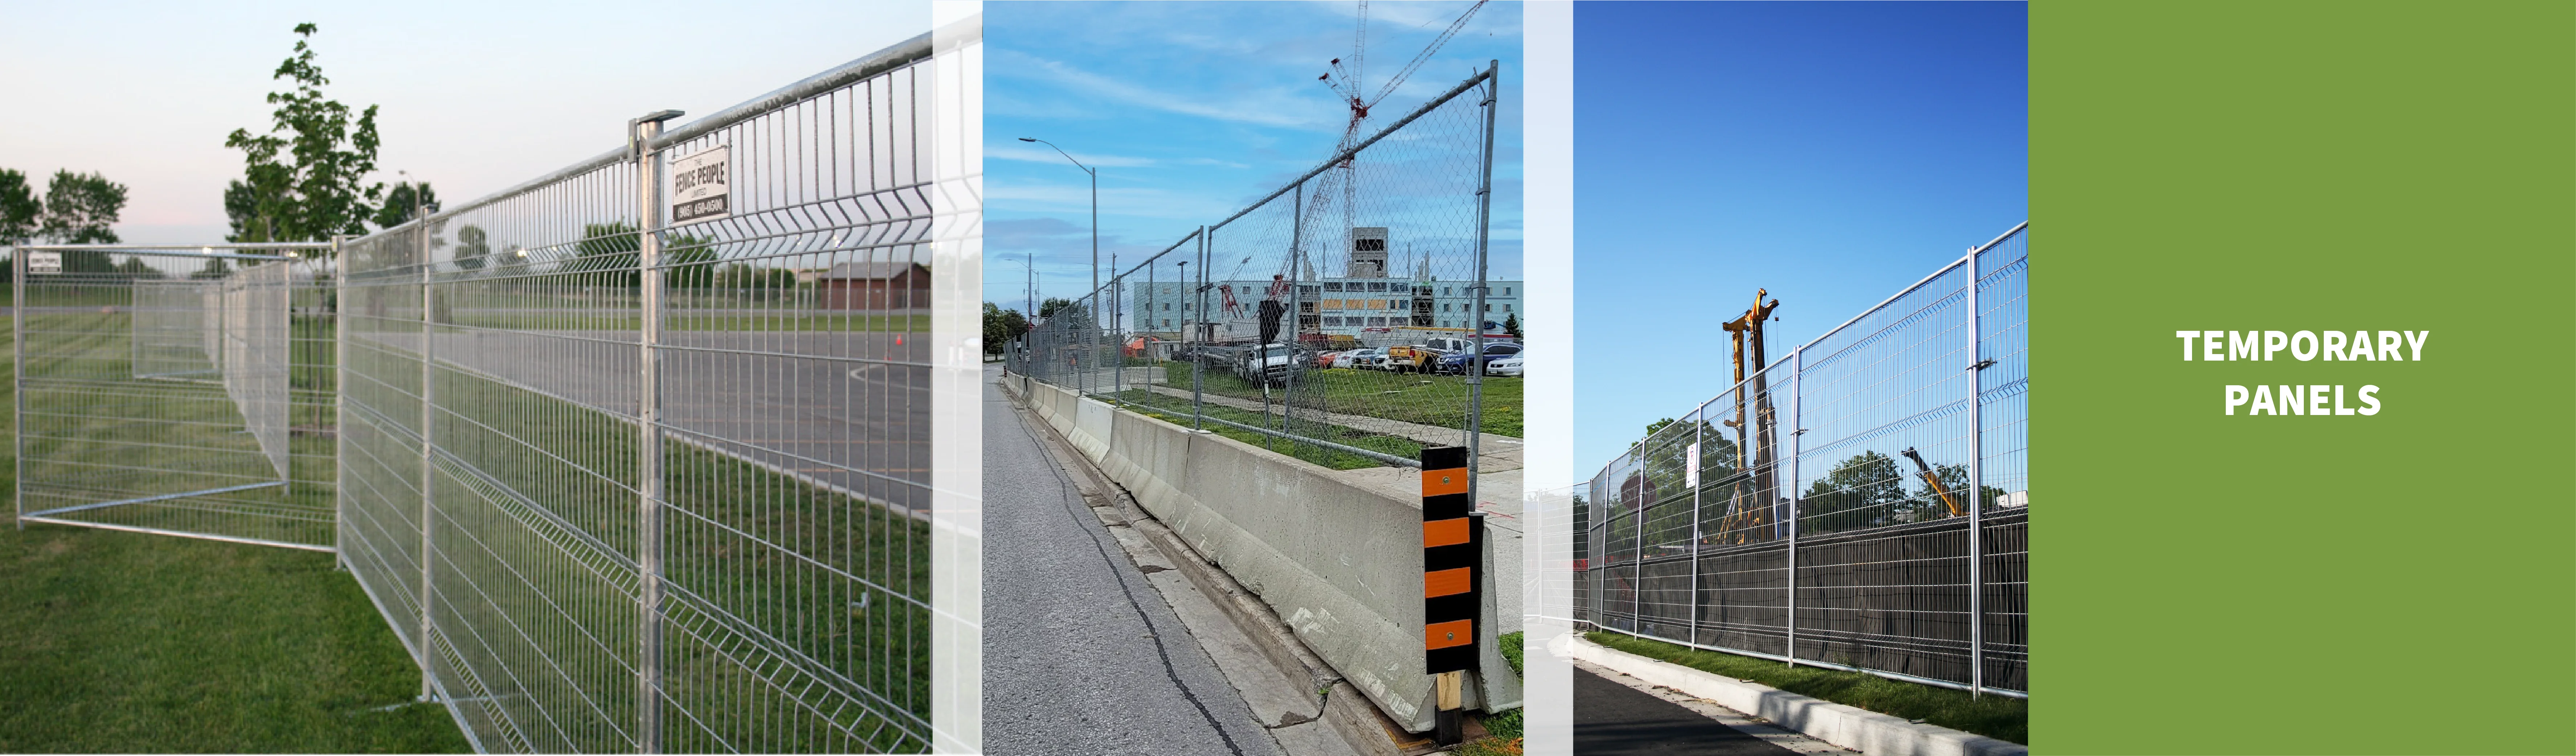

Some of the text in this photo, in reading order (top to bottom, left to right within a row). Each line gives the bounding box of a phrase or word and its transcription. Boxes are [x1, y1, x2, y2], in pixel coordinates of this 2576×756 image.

[675, 161, 725, 196] FENCE PEOPLE
[1624, 488, 1655, 501] STP
